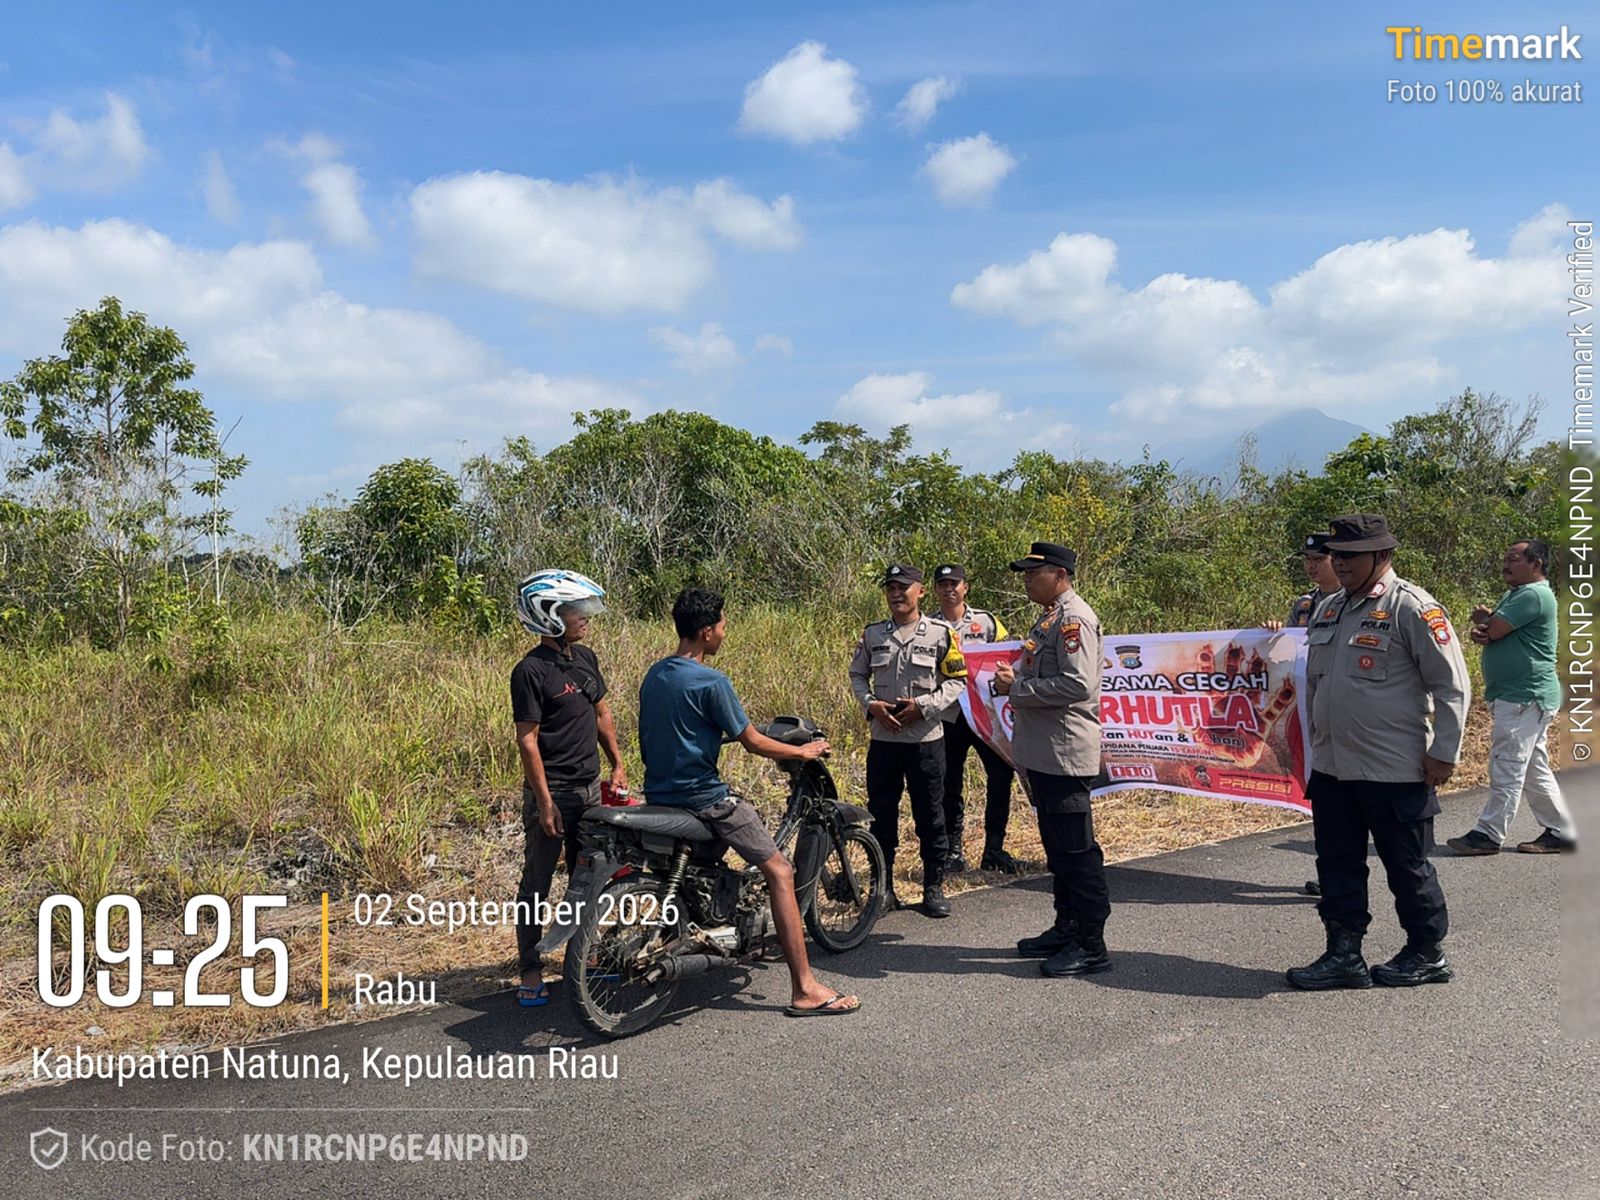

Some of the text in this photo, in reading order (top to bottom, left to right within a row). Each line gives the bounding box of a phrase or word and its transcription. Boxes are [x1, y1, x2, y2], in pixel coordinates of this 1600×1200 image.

[1360, 621, 1391, 631] POLRI
[913, 645, 937, 655] POLRI
[1176, 671, 1269, 692] CEGAH
[1127, 730, 1174, 742] HUTan
[1177, 732, 1190, 744] &
[1112, 766, 1153, 778] 110
